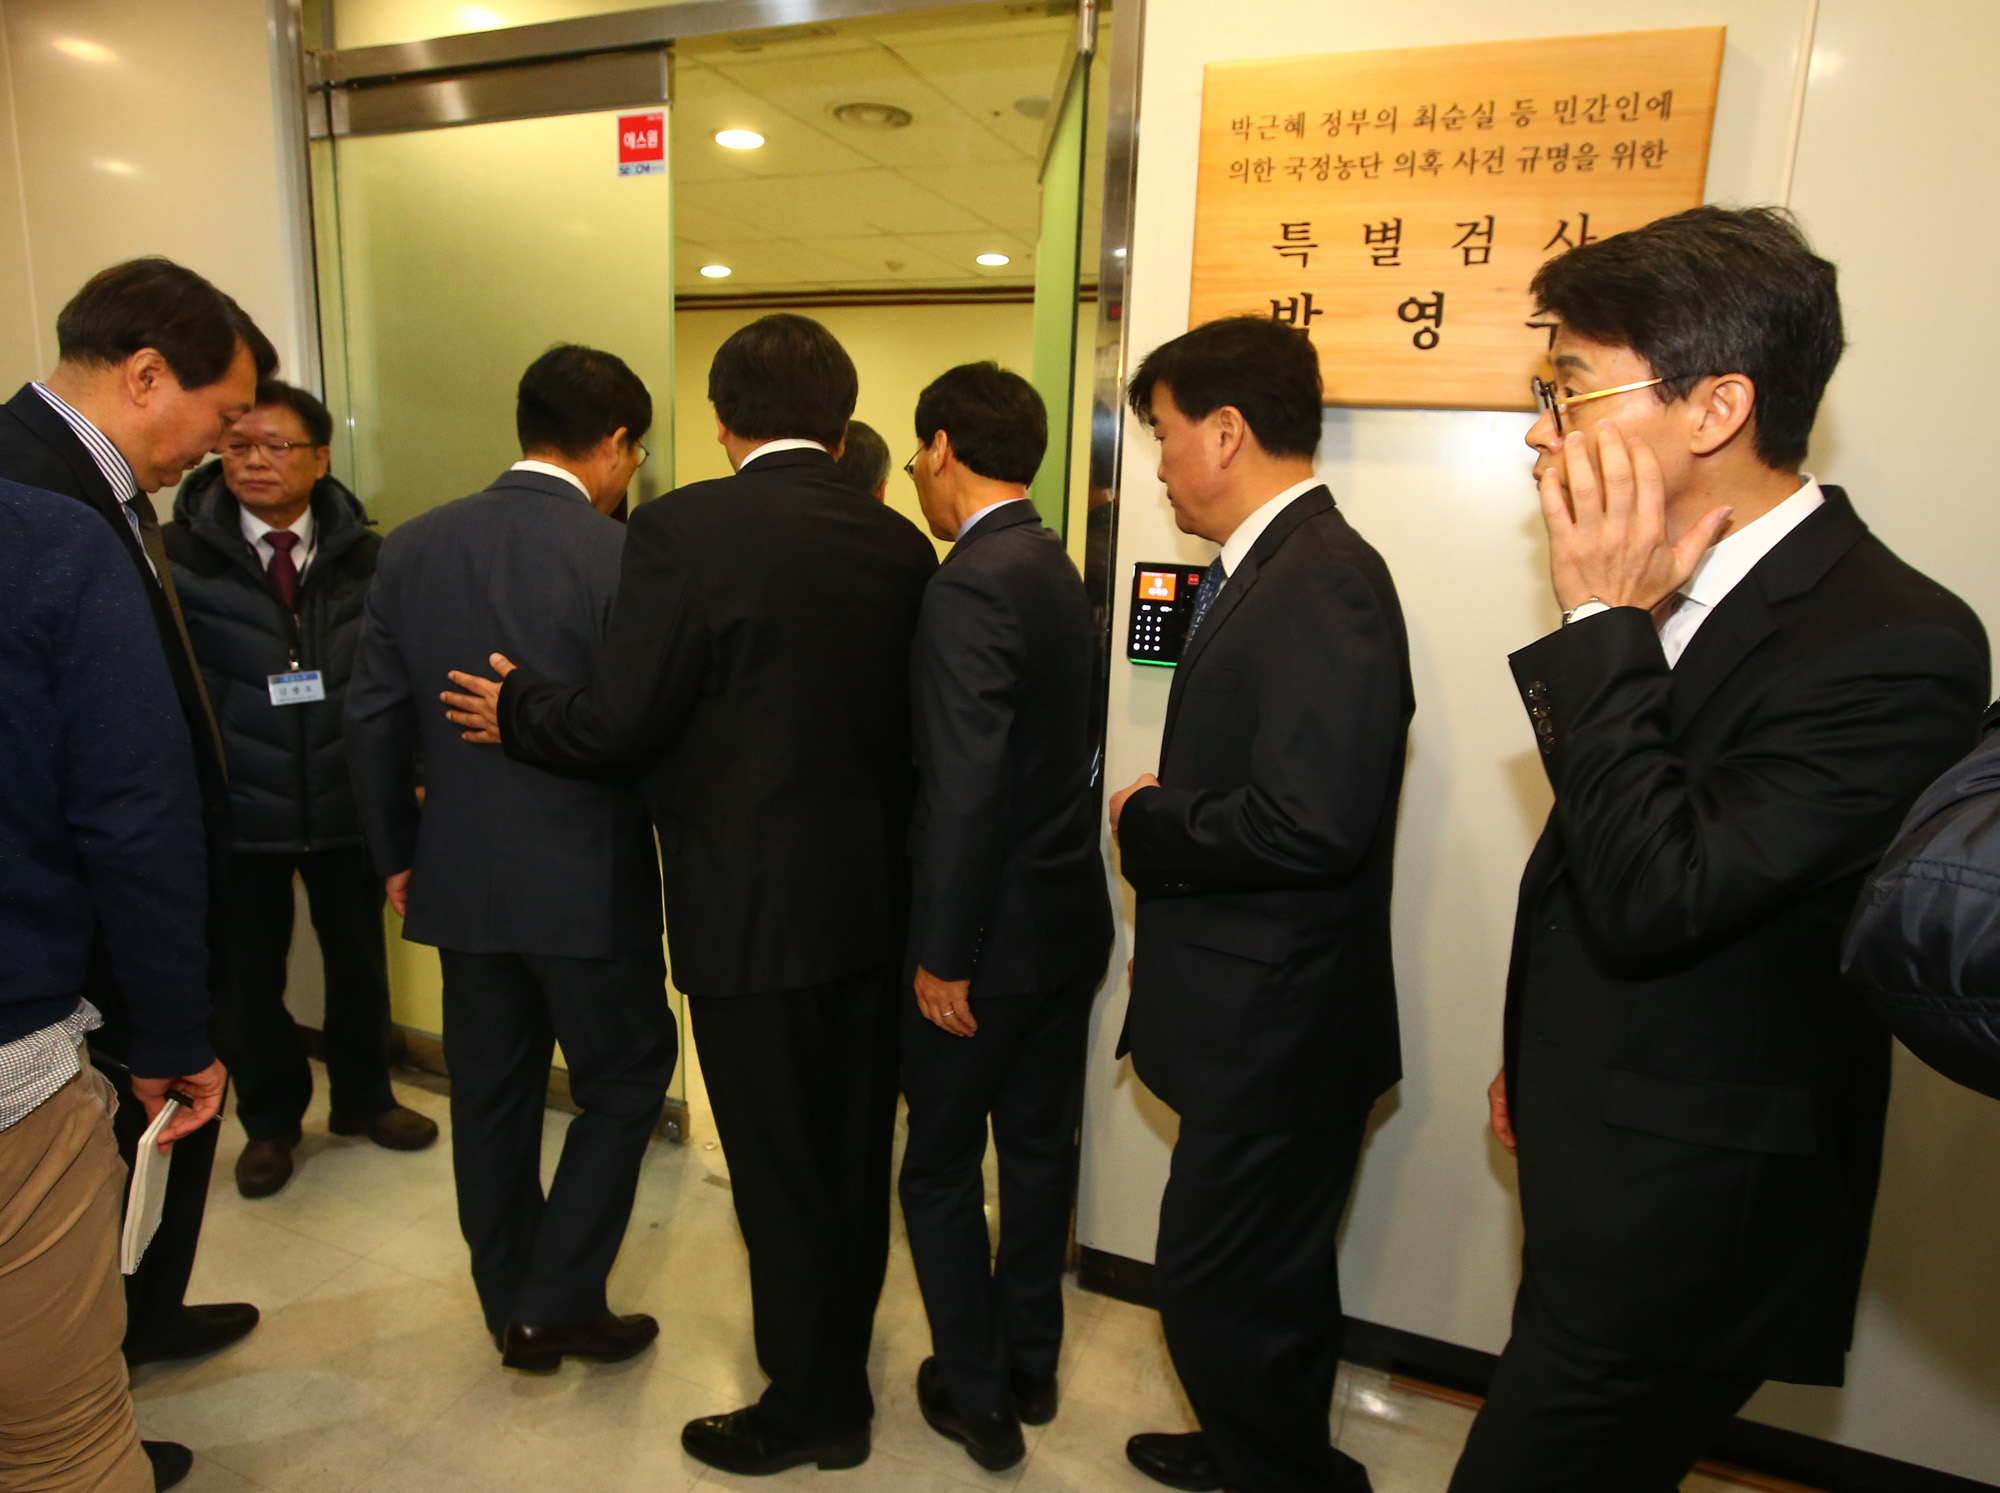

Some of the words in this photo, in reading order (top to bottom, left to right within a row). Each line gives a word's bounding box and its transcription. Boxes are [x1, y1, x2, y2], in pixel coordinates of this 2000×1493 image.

[1231, 111, 1305, 141] 박근혜
[1321, 106, 1397, 137] 정부의
[1413, 100, 1495, 132] 최순실
[1510, 98, 1538, 128] 등
[1554, 90, 1673, 125] 민간인에
[623, 129, 658, 150] 에스원
[1229, 156, 1275, 184] 의한
[1284, 151, 1383, 182] 국정농단
[1393, 149, 1444, 178] 의혹
[1452, 145, 1505, 175] 사건
[1517, 142, 1600, 173] 규명을
[1611, 138, 1669, 170] 위한
